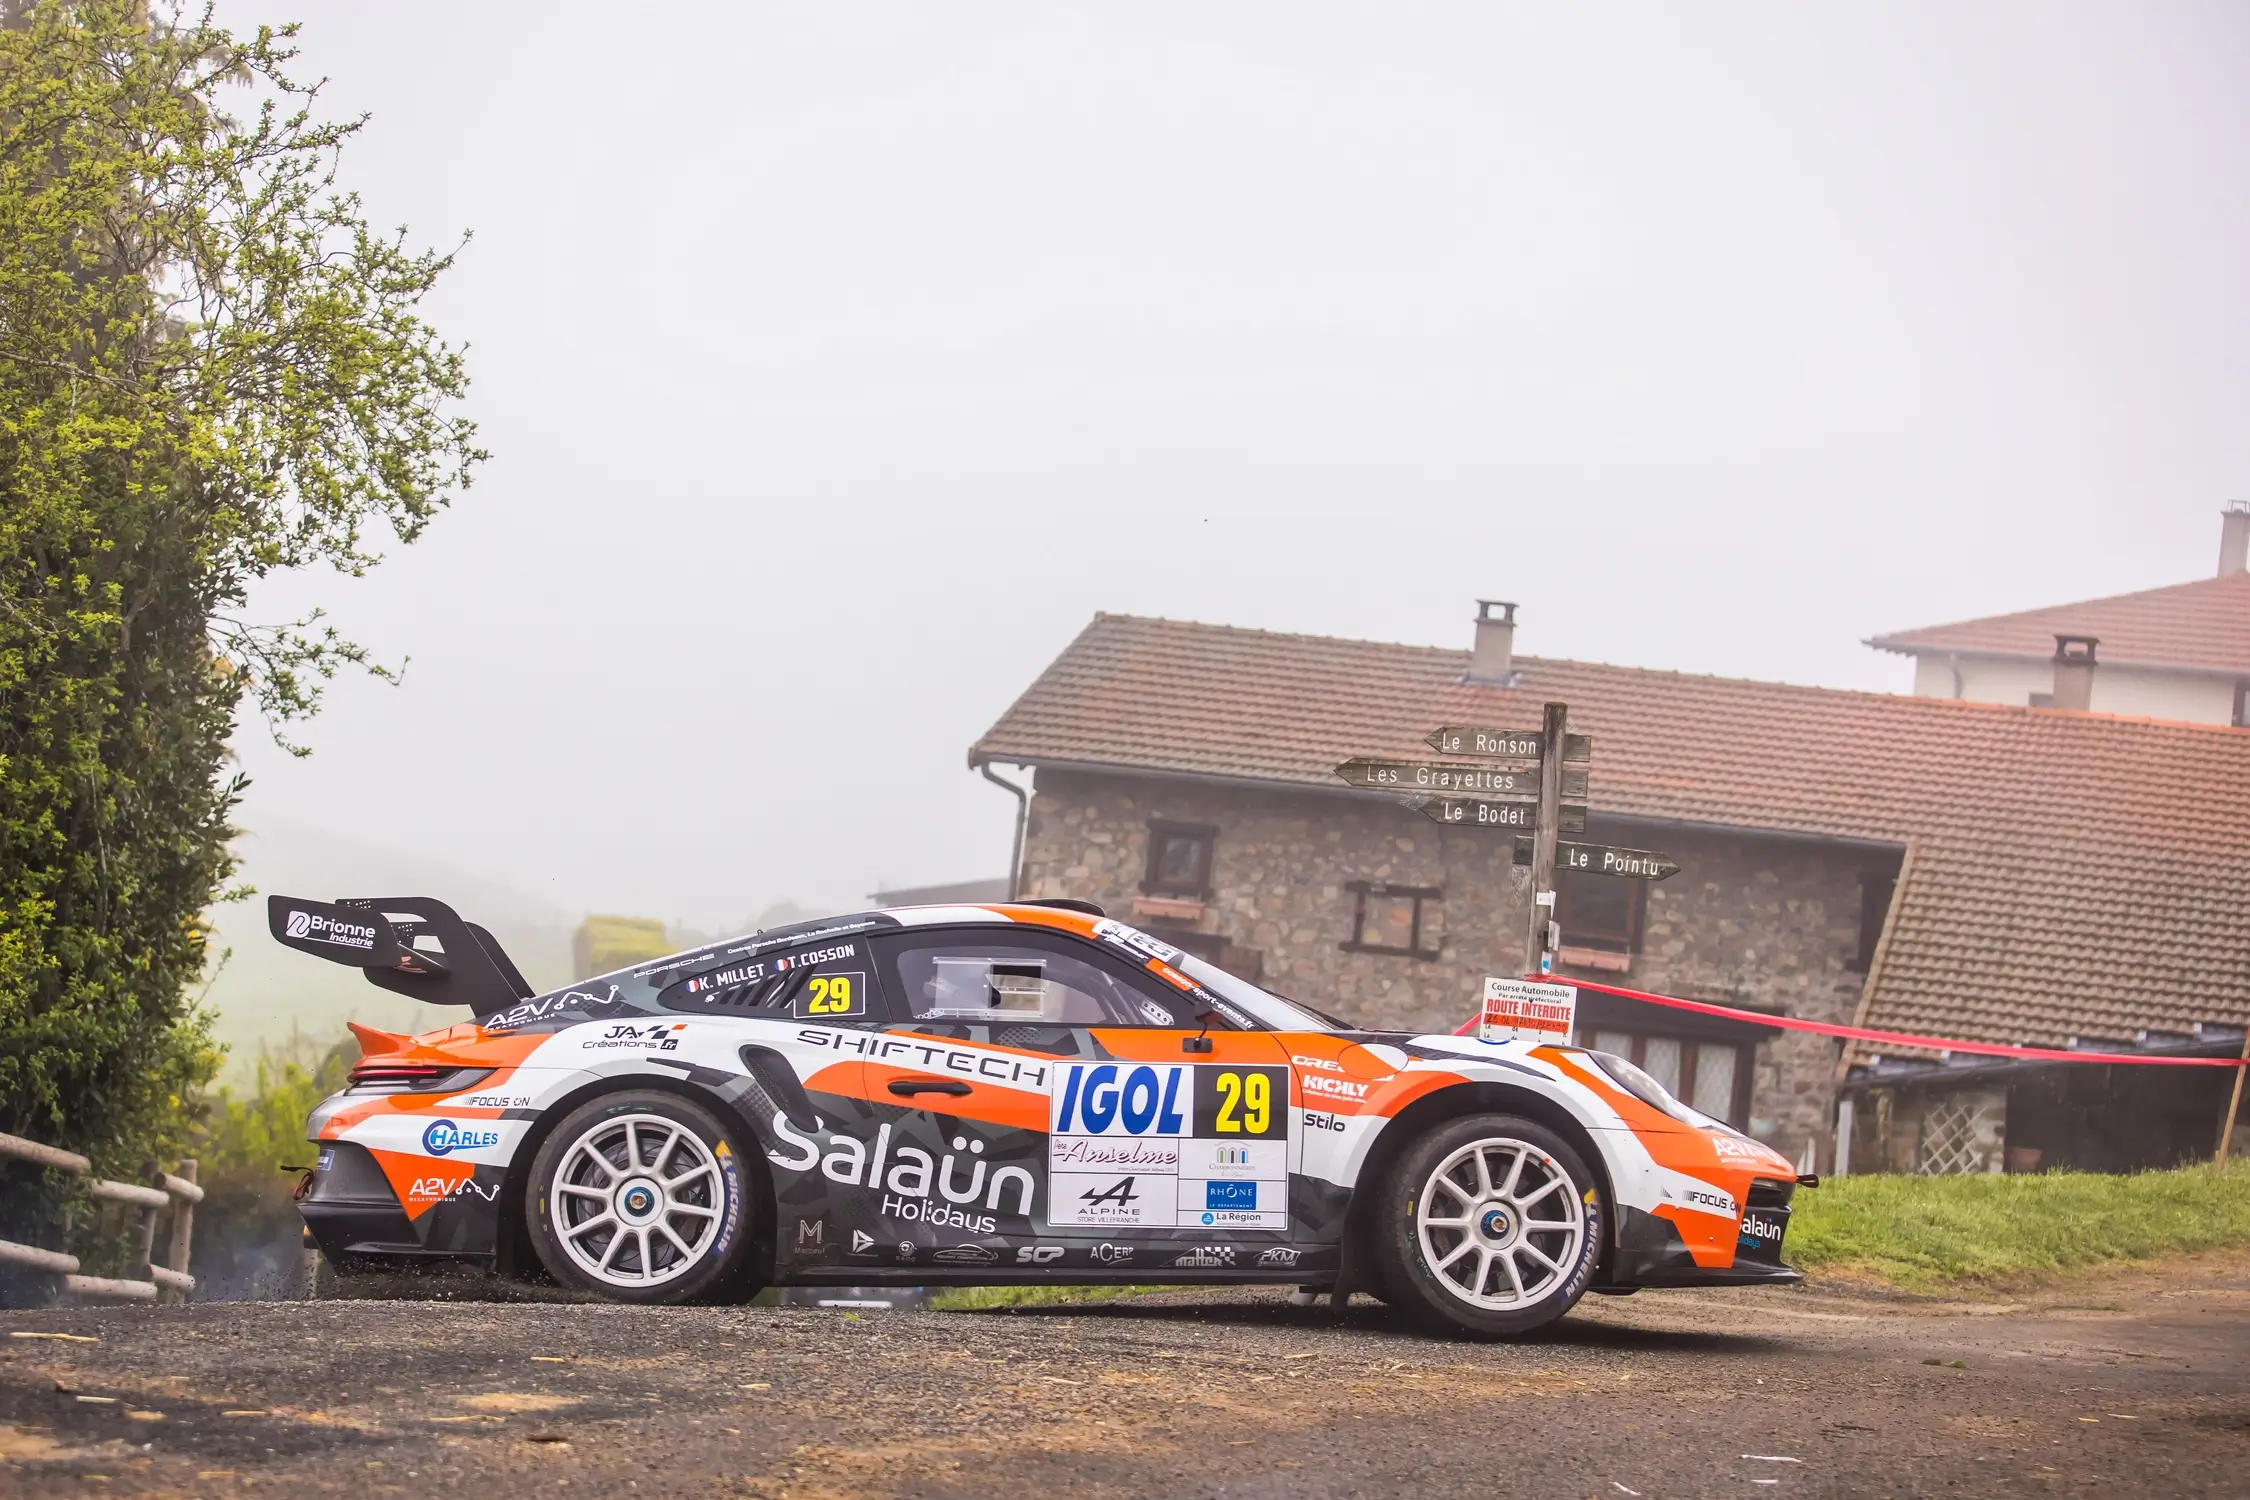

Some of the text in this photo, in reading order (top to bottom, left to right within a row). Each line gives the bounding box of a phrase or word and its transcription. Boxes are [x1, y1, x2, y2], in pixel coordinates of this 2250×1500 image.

[1442, 732, 1537, 755] Le Ronson
[1366, 765, 1514, 790] Les Grayettes
[1444, 802, 1525, 825] Le Bodet
[1569, 848, 1659, 876] Le Pointu
[310, 915, 376, 938] Brionne
[329, 932, 374, 947] Industrie
[752, 938, 777, 949] Porsche
[633, 953, 715, 978] PORSCHE
[788, 944, 855, 969] T.COSSON
[699, 963, 765, 990] K. MILLET
[808, 977, 851, 1014] 29
[1162, 967, 1254, 1029] cosson-sport-events.fr
[1491, 982, 1570, 999] Course Automobile
[483, 997, 553, 1030] A2V
[1486, 998, 1572, 1020] ROUTE INTERDITE
[582, 1040, 657, 1049] Créations
[797, 1029, 1046, 1087] SHIFTECH
[470, 1096, 531, 1107] FOCUS ON
[1057, 1064, 1184, 1135] IGOL
[1215, 1072, 1271, 1134] 29
[1304, 1113, 1346, 1132] Stilo
[422, 1119, 499, 1156] CHARLES
[767, 1109, 1035, 1216] Salaün
[1054, 1139, 1177, 1165] Anselme
[409, 1177, 457, 1196] A2V
[1210, 1183, 1253, 1198] RHÔNE
[717, 1171, 739, 1253] MICHELIN
[881, 1194, 997, 1234] Holidays
[1078, 1208, 1140, 1216] ALPINE
[1692, 1191, 1742, 1213] FOCUS ON
[1098, 1216, 1140, 1224] VILLEFRANCHE
[1216, 1212, 1261, 1222] La Région
[1740, 1213, 1781, 1241] alaün
[1015, 1246, 1065, 1263] SCP
[1259, 1250, 1295, 1262] PKM
[1564, 1220, 1598, 1298] MICHELIN
